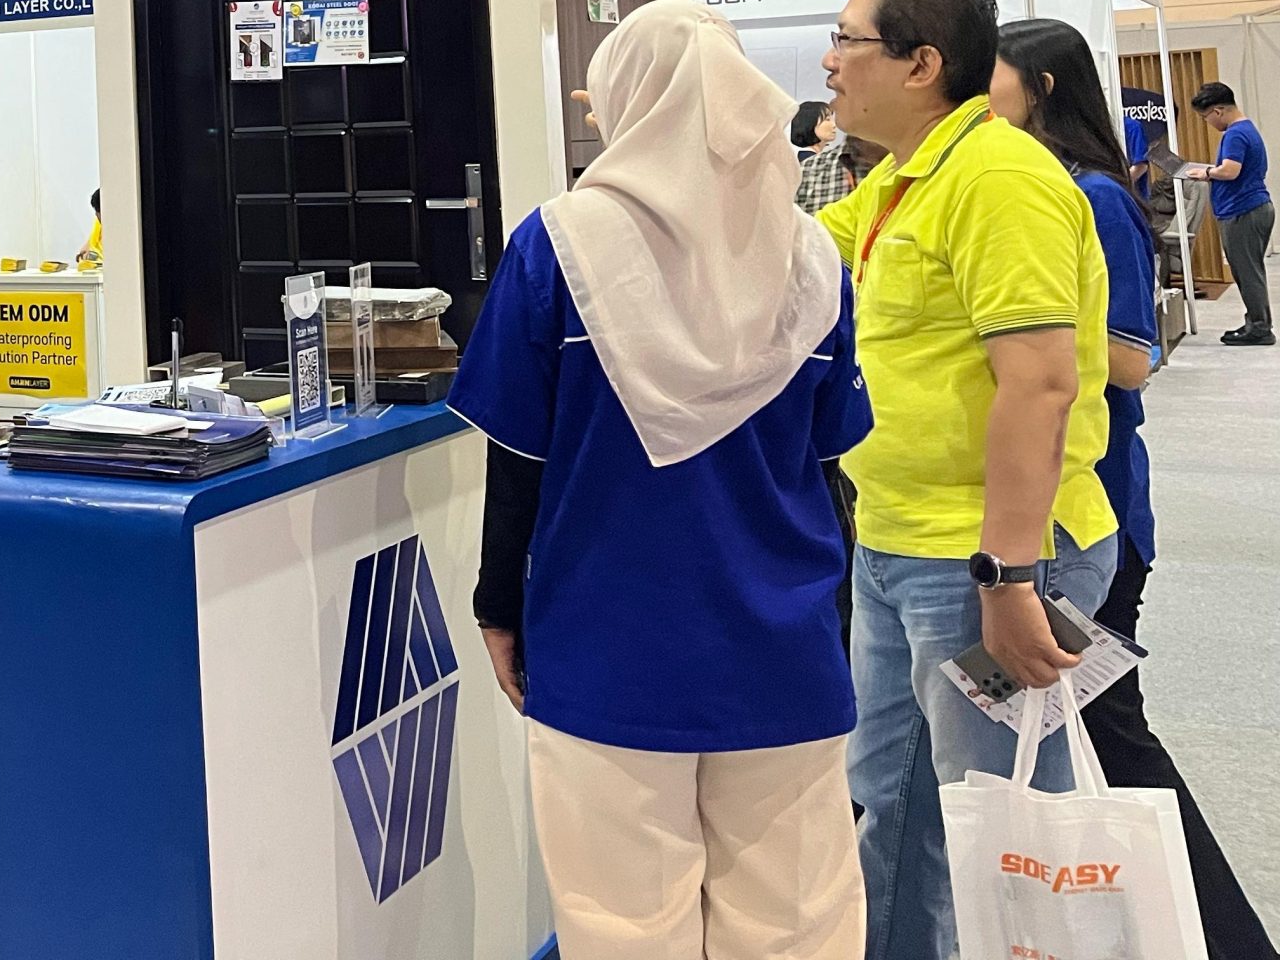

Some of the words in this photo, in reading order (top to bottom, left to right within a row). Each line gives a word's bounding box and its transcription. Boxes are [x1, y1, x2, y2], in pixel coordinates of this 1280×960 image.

[4, 0, 50, 15] LAYER
[28, 304, 69, 322] ODM
[295, 327, 306, 339] Scan
[307, 325, 318, 336] Here
[32, 351, 78, 366] Partner
[1000, 853, 1121, 893] SOEASY
